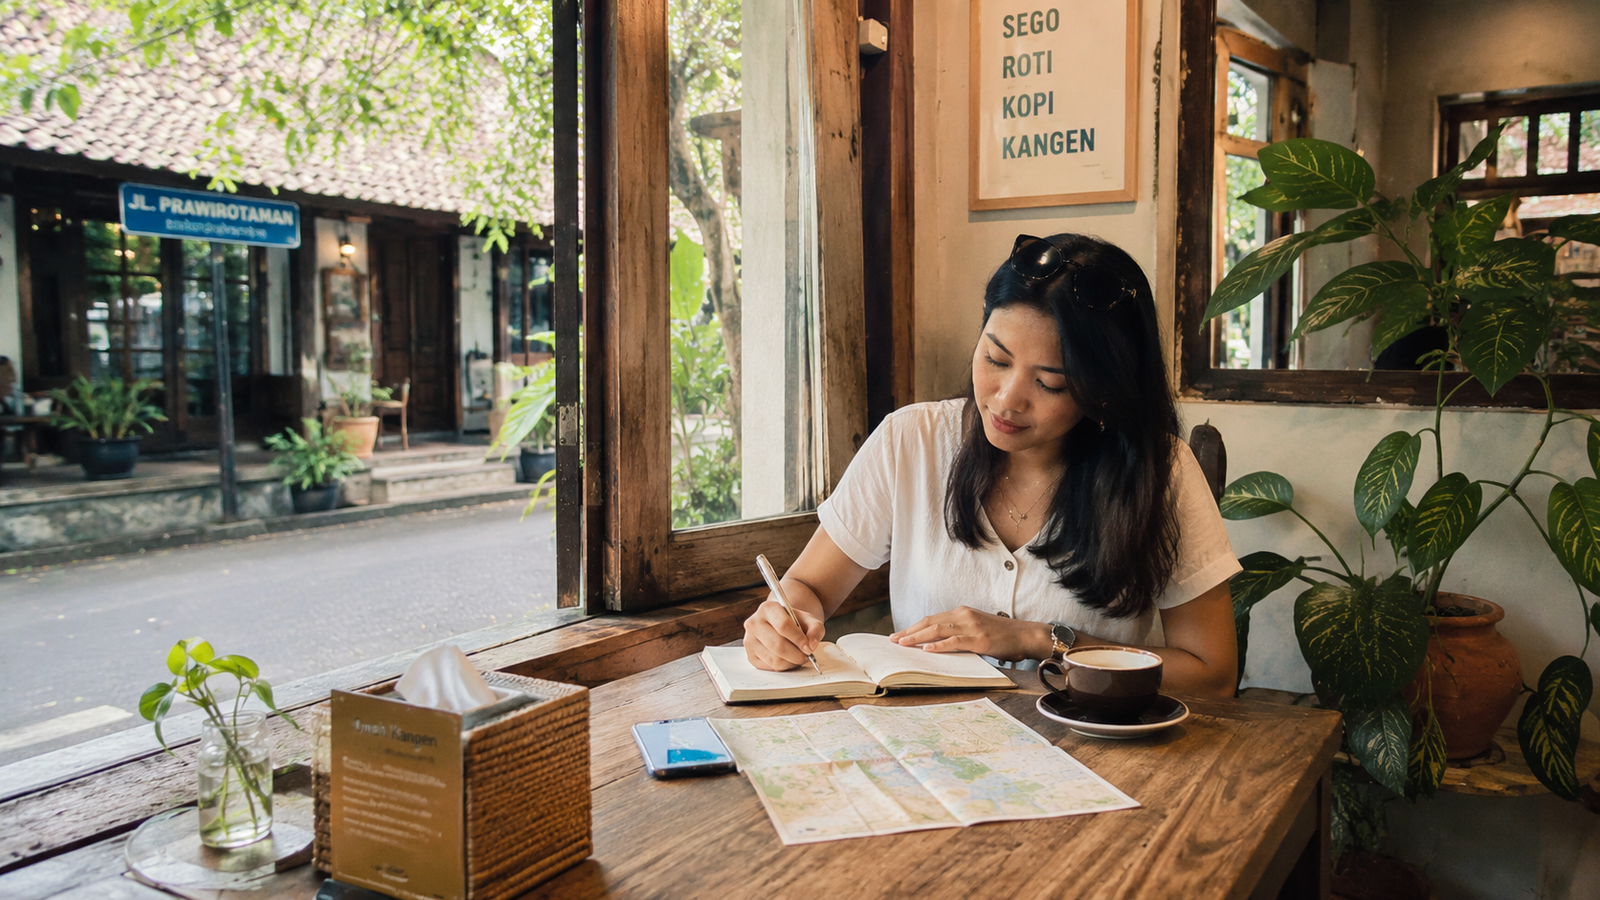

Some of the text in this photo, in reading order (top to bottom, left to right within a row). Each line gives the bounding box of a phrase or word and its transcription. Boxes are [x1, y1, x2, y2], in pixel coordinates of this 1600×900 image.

[1002, 8, 1060, 38] SEGO
[1002, 50, 1052, 79] ROTI
[1002, 91, 1054, 119] KOPI
[1002, 128, 1095, 159] KANGEN
[128, 194, 294, 226] JL. PRAWIROTAMAN
